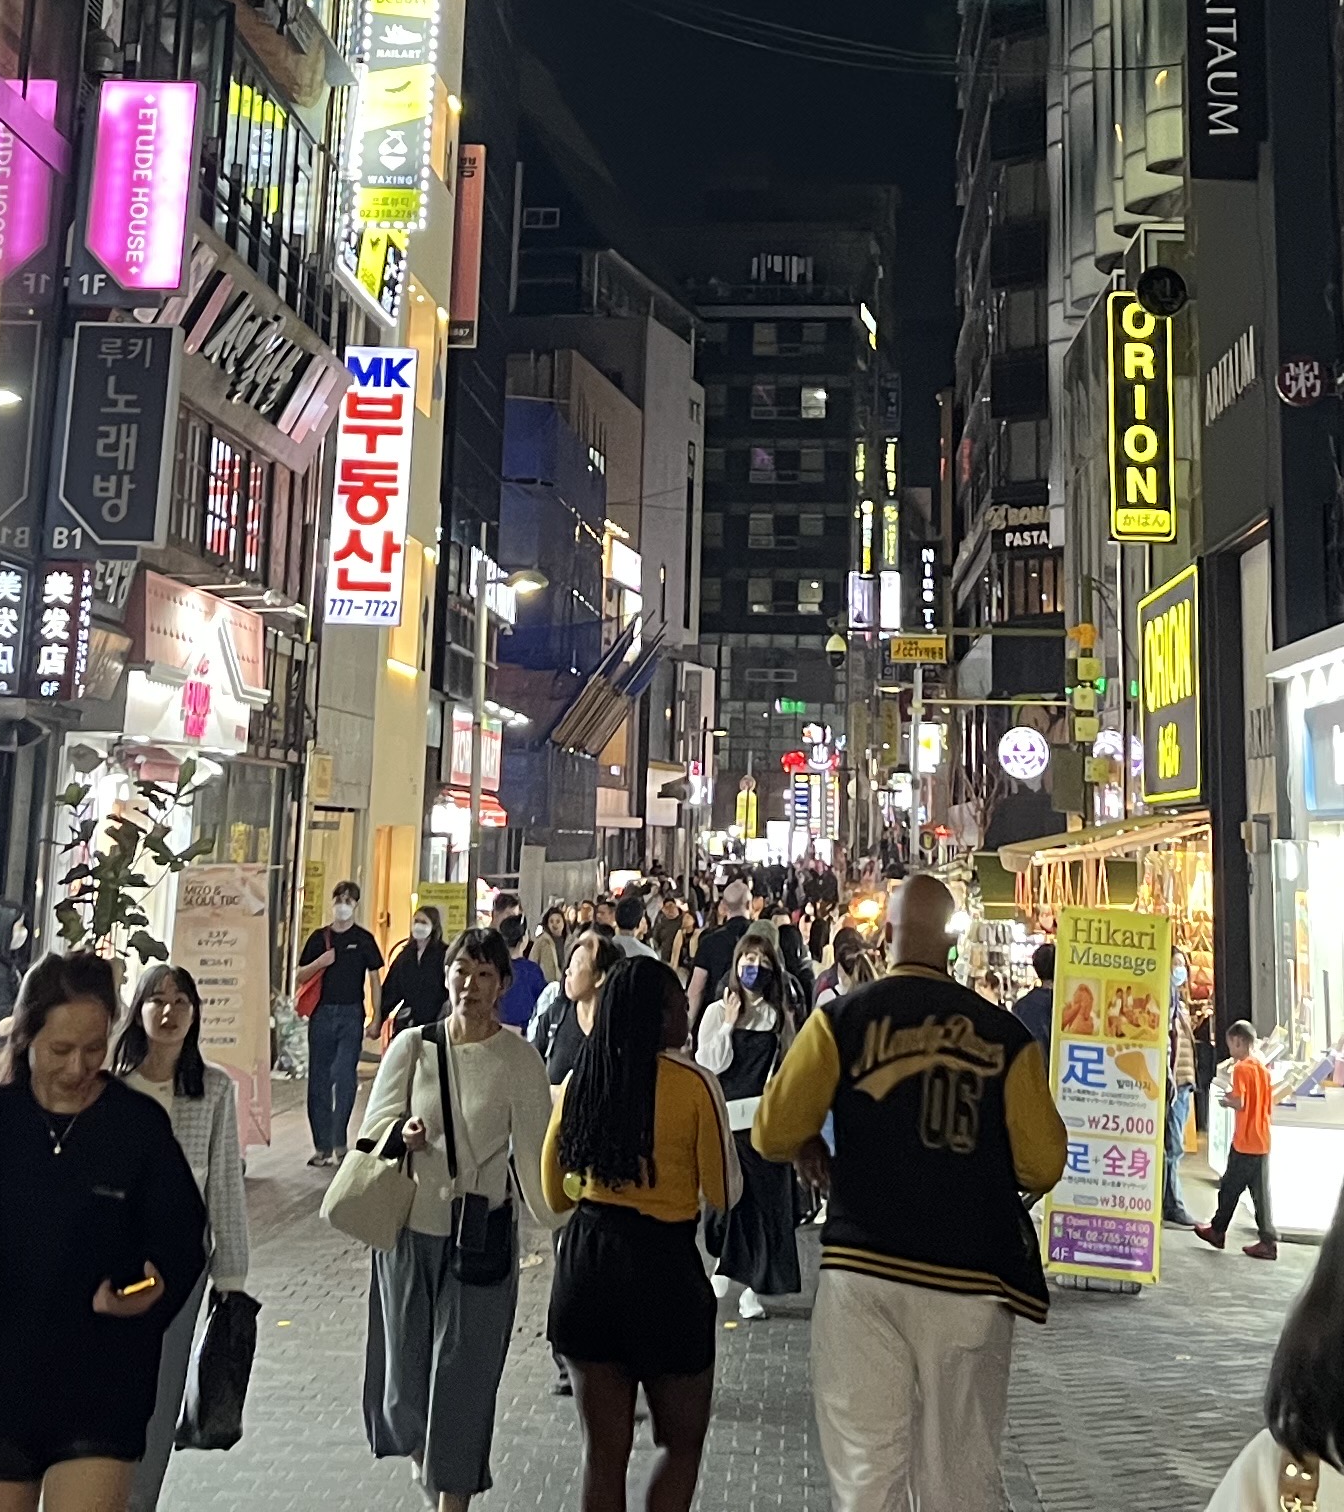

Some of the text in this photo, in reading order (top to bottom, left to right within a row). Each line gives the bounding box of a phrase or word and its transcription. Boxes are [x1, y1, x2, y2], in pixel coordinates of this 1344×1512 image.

[126, 107, 159, 264] ETUDE HOUSE
[367, 174, 413, 185] WAXING
[78, 275, 107, 295] 1F
[97, 337, 154, 368] 루키
[347, 356, 414, 389] MK
[1205, 325, 1256, 427] ARITAUM
[1122, 301, 1157, 505] ORION
[92, 376, 143, 524] 노래방
[333, 391, 404, 593] 부동산
[1123, 513, 1165, 527] かばん
[52, 527, 83, 550] B1
[1005, 530, 1049, 547] PASTA
[36, 571, 75, 677] 美发店
[328, 598, 398, 617] 777-7727
[1144, 598, 1193, 713] ORION
[1069, 916, 1157, 950] Hikari
[1069, 944, 1157, 977] Massage
[1062, 1043, 1108, 1088] 足
[1087, 1113, 1155, 1136] ₩25,000
[1051, 1246, 1070, 1261] 4F
